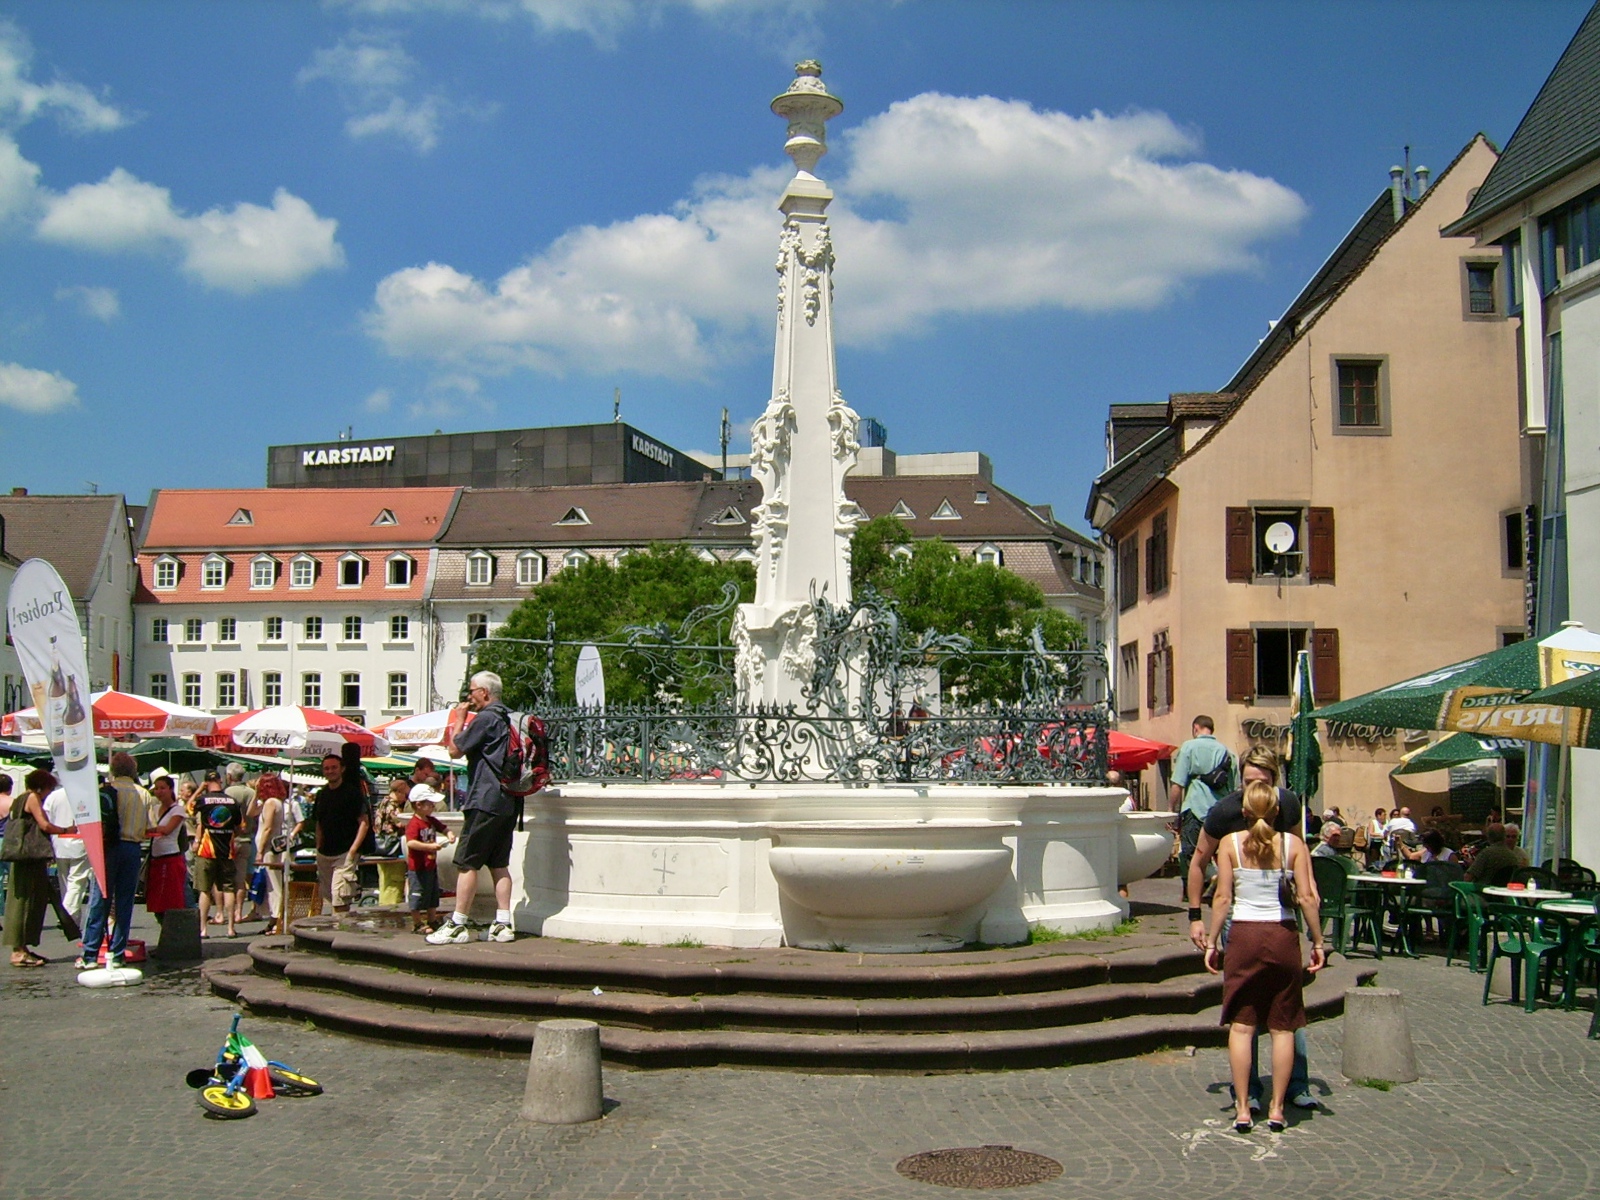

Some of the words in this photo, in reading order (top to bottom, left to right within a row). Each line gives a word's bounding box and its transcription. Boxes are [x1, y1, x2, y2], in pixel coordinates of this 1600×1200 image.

[302, 445, 395, 466] KARSTADT
[632, 433, 674, 468] KARSTADT
[99, 719, 155, 730] BRUCH
[245, 732, 291, 746] Zwickel
[394, 729, 439, 740] SaarGold
